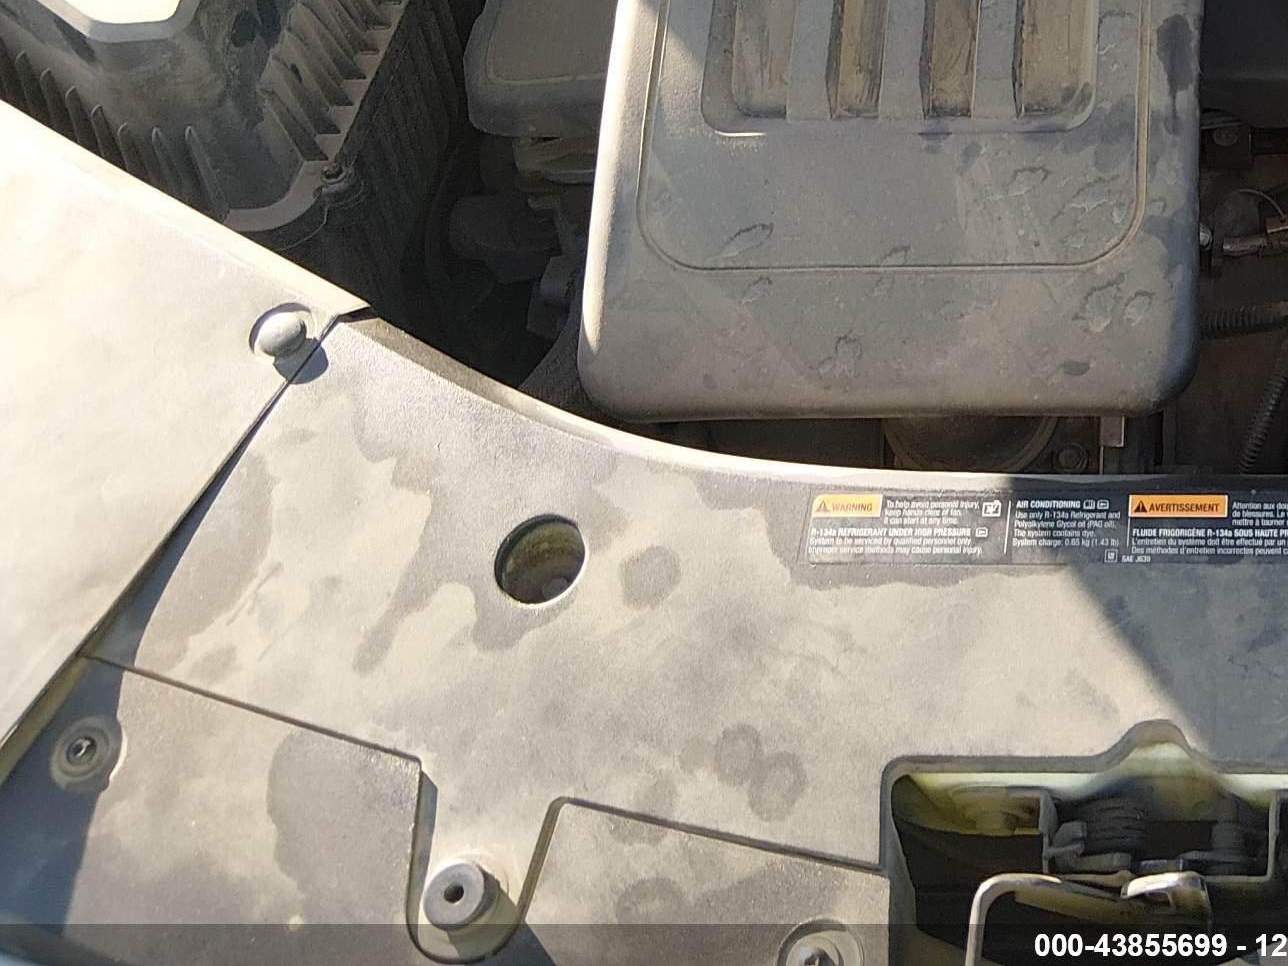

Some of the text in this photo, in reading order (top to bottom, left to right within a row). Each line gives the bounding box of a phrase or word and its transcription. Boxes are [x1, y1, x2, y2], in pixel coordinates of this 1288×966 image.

[832, 503, 872, 512] WARNING
[886, 500, 892, 509] To
[894, 500, 909, 509] help
[911, 500, 929, 509] avoid
[930, 500, 958, 509] personal
[1016, 500, 1080, 508] AIR CONDITIONING
[1149, 504, 1219, 512] AVERTISSEMENT
[1232, 502, 1261, 510] Attention
[1263, 502, 1274, 510] aux
[1232, 510, 1240, 518] de
[1277, 510, 1284, 518] Le
[1056, 520, 1076, 528] Glycol
[811, 528, 970, 536] R-134a REFRIGERANT UNDER HIGH PRESSURE
[1014, 529, 1096, 537] The system contains dye.
[1132, 528, 1156, 536] FLUIDE
[1207, 528, 1232, 536] R-134a
[1234, 528, 1253, 536] SOUS
[1255, 528, 1278, 536] HAUTE
[809, 538, 834, 546] System
[844, 538, 854, 546] be
[894, 538, 922, 546] qualified
[924, 538, 956, 546] personnel
[1012, 538, 1036, 546] System
[1082, 538, 1090, 546] kg
[1168, 538, 1176, 546] du
[1207, 538, 1219, 546] doit
[1222, 538, 1234, 546] être
[1236, 538, 1262, 546] effectué
[1264, 538, 1276, 546] par
[1278, 538, 1285, 546] un
[840, 546, 864, 555] service
[865, 546, 893, 555] methods
[896, 546, 910, 555] may
[912, 546, 930, 555] cause
[932, 546, 961, 555] personal
[1132, 547, 1144, 555] Des
[1146, 547, 1178, 555] méthodes
[1180, 547, 1215, 555] d'entretien
[1217, 547, 1253, 555] incorrectes
[1255, 547, 1281, 555] peuvent
